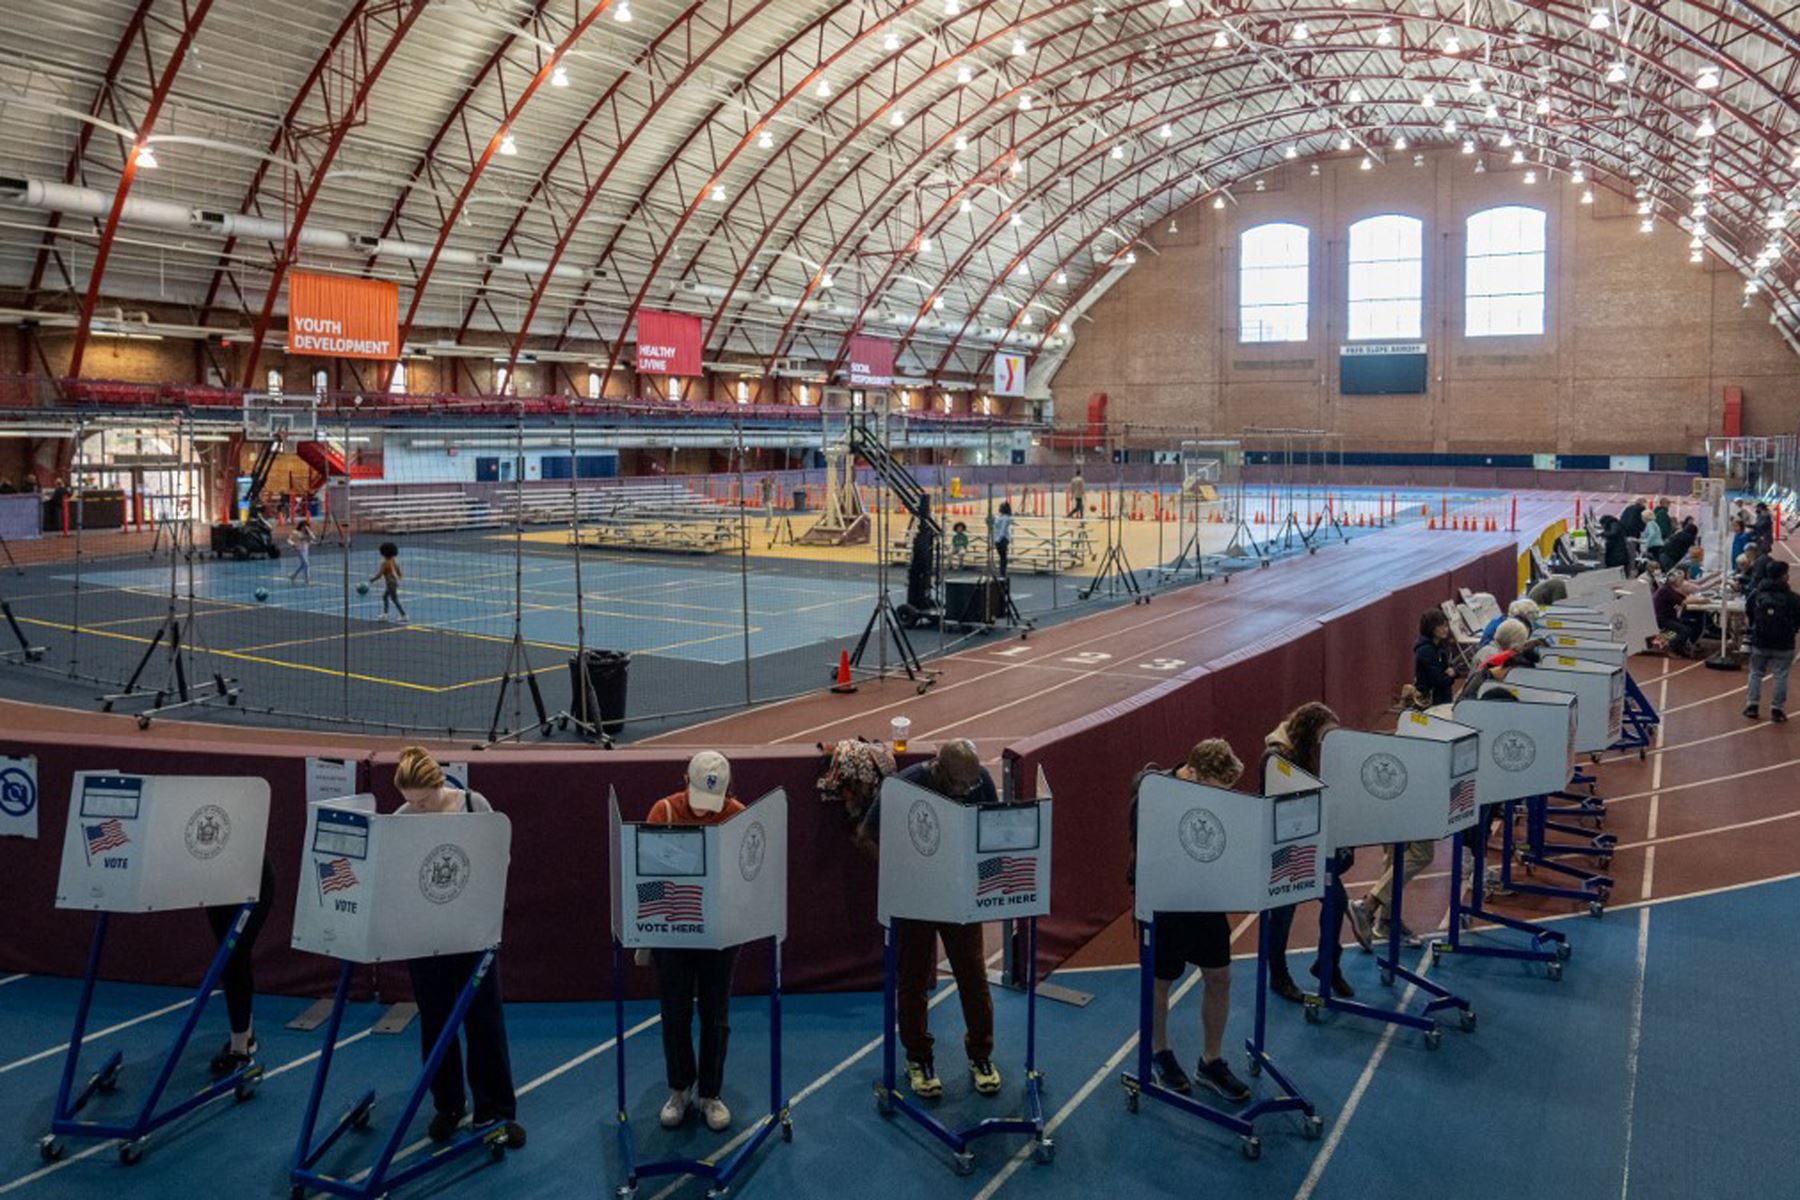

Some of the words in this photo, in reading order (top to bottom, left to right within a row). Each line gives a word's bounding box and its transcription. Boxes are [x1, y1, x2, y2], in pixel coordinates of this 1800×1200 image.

[294, 317, 342, 334] YOUTH
[294, 334, 389, 354] DEVELOPMENT
[639, 345, 676, 358] HEALTHY
[639, 358, 667, 371] LIVING
[104, 857, 128, 869] VOTE
[1268, 885, 1290, 896] VOTE
[1292, 880, 1315, 890] HERE
[335, 899, 358, 914] VOTE
[976, 897, 1005, 908] VOTE
[1008, 894, 1037, 904] HERE
[636, 923, 669, 933] VOTE
[671, 924, 704, 934] HERE
